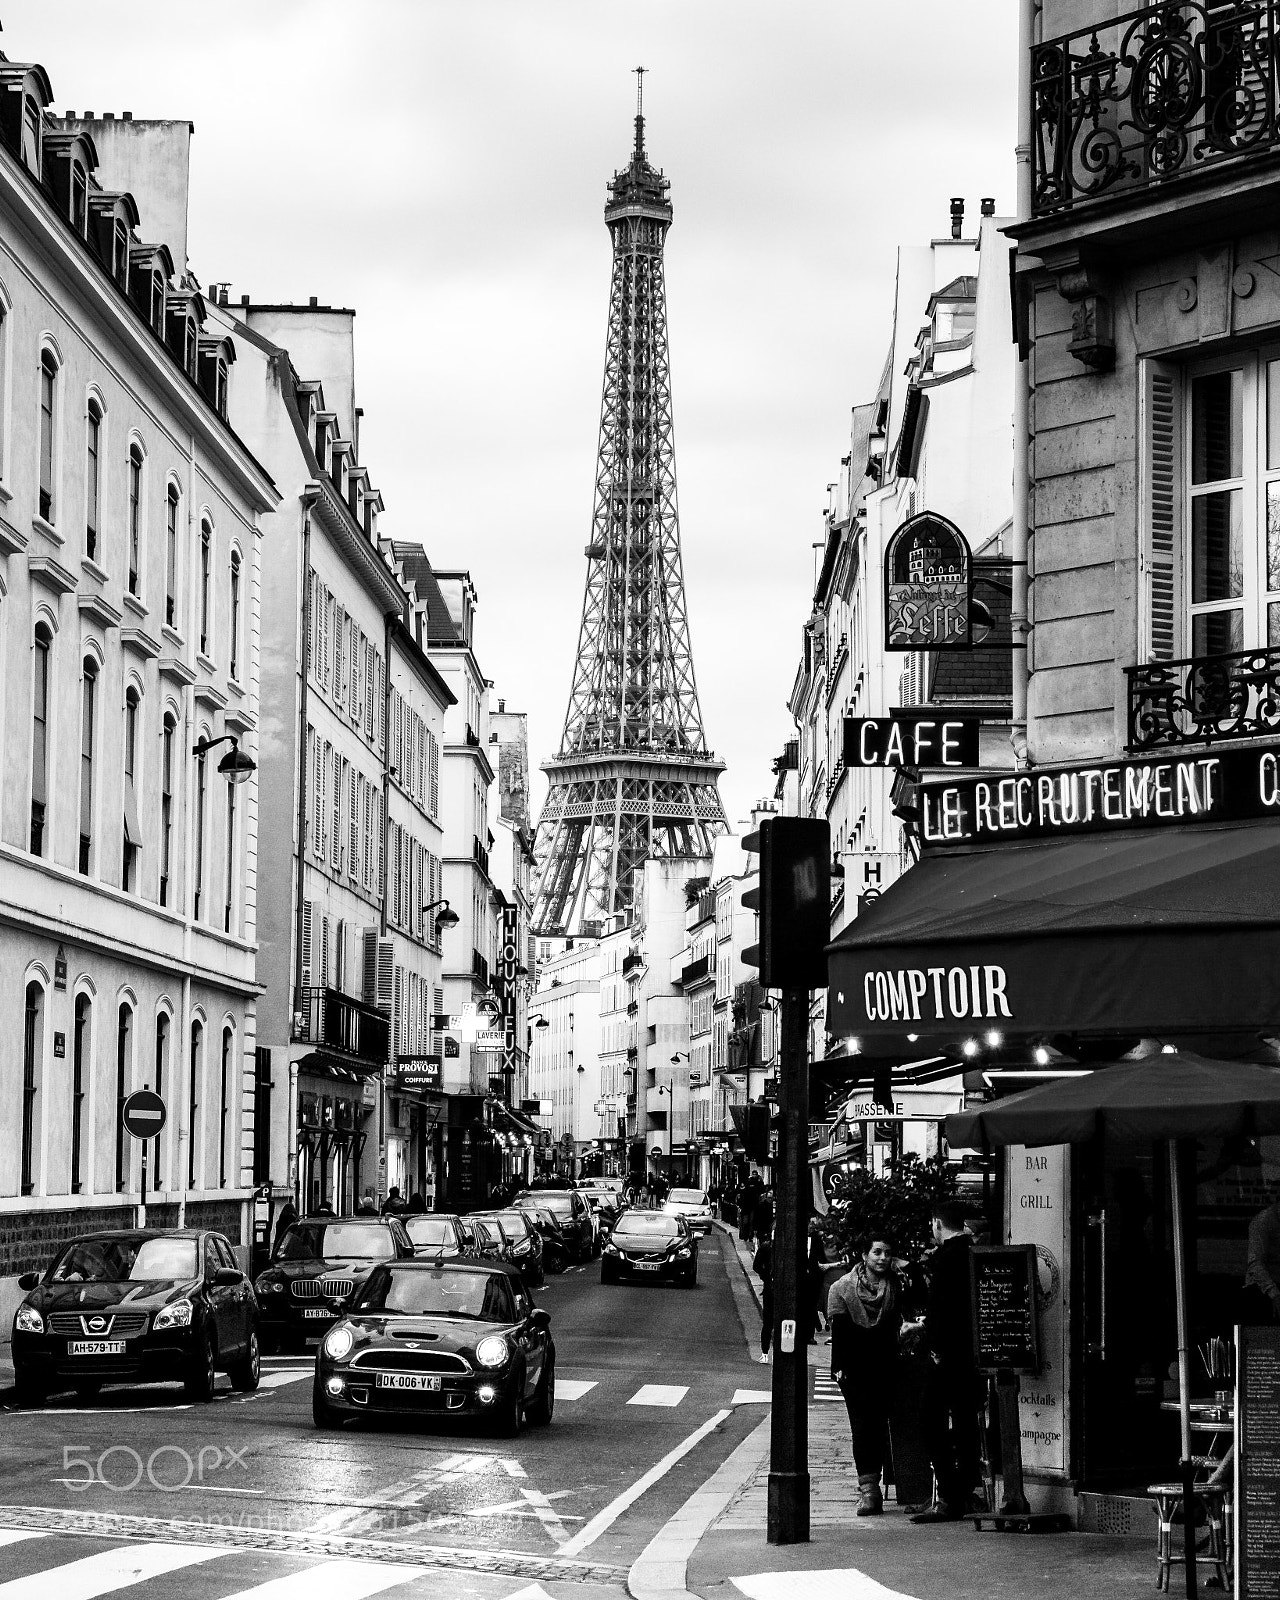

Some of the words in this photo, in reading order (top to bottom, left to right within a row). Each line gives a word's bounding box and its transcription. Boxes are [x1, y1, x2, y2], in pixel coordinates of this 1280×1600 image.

[889, 601, 967, 643] Leffe
[860, 720, 964, 766] CAFE
[975, 758, 1220, 832] RECRUTEMENT
[502, 908, 516, 1070] THOUMIEUX
[864, 965, 1014, 1021] COMPTOIR
[477, 1031, 505, 1040] LAVERIE
[399, 1063, 439, 1074] PROVOST
[1025, 1156, 1048, 1170] BAR
[1020, 1195, 1053, 1209] GRILL
[74, 1342, 120, 1353] AH-579-TT
[383, 1375, 433, 1389] DK-006-VK
[1020, 1391, 1056, 1407] ocktails
[1019, 1430, 1062, 1446] ampagne
